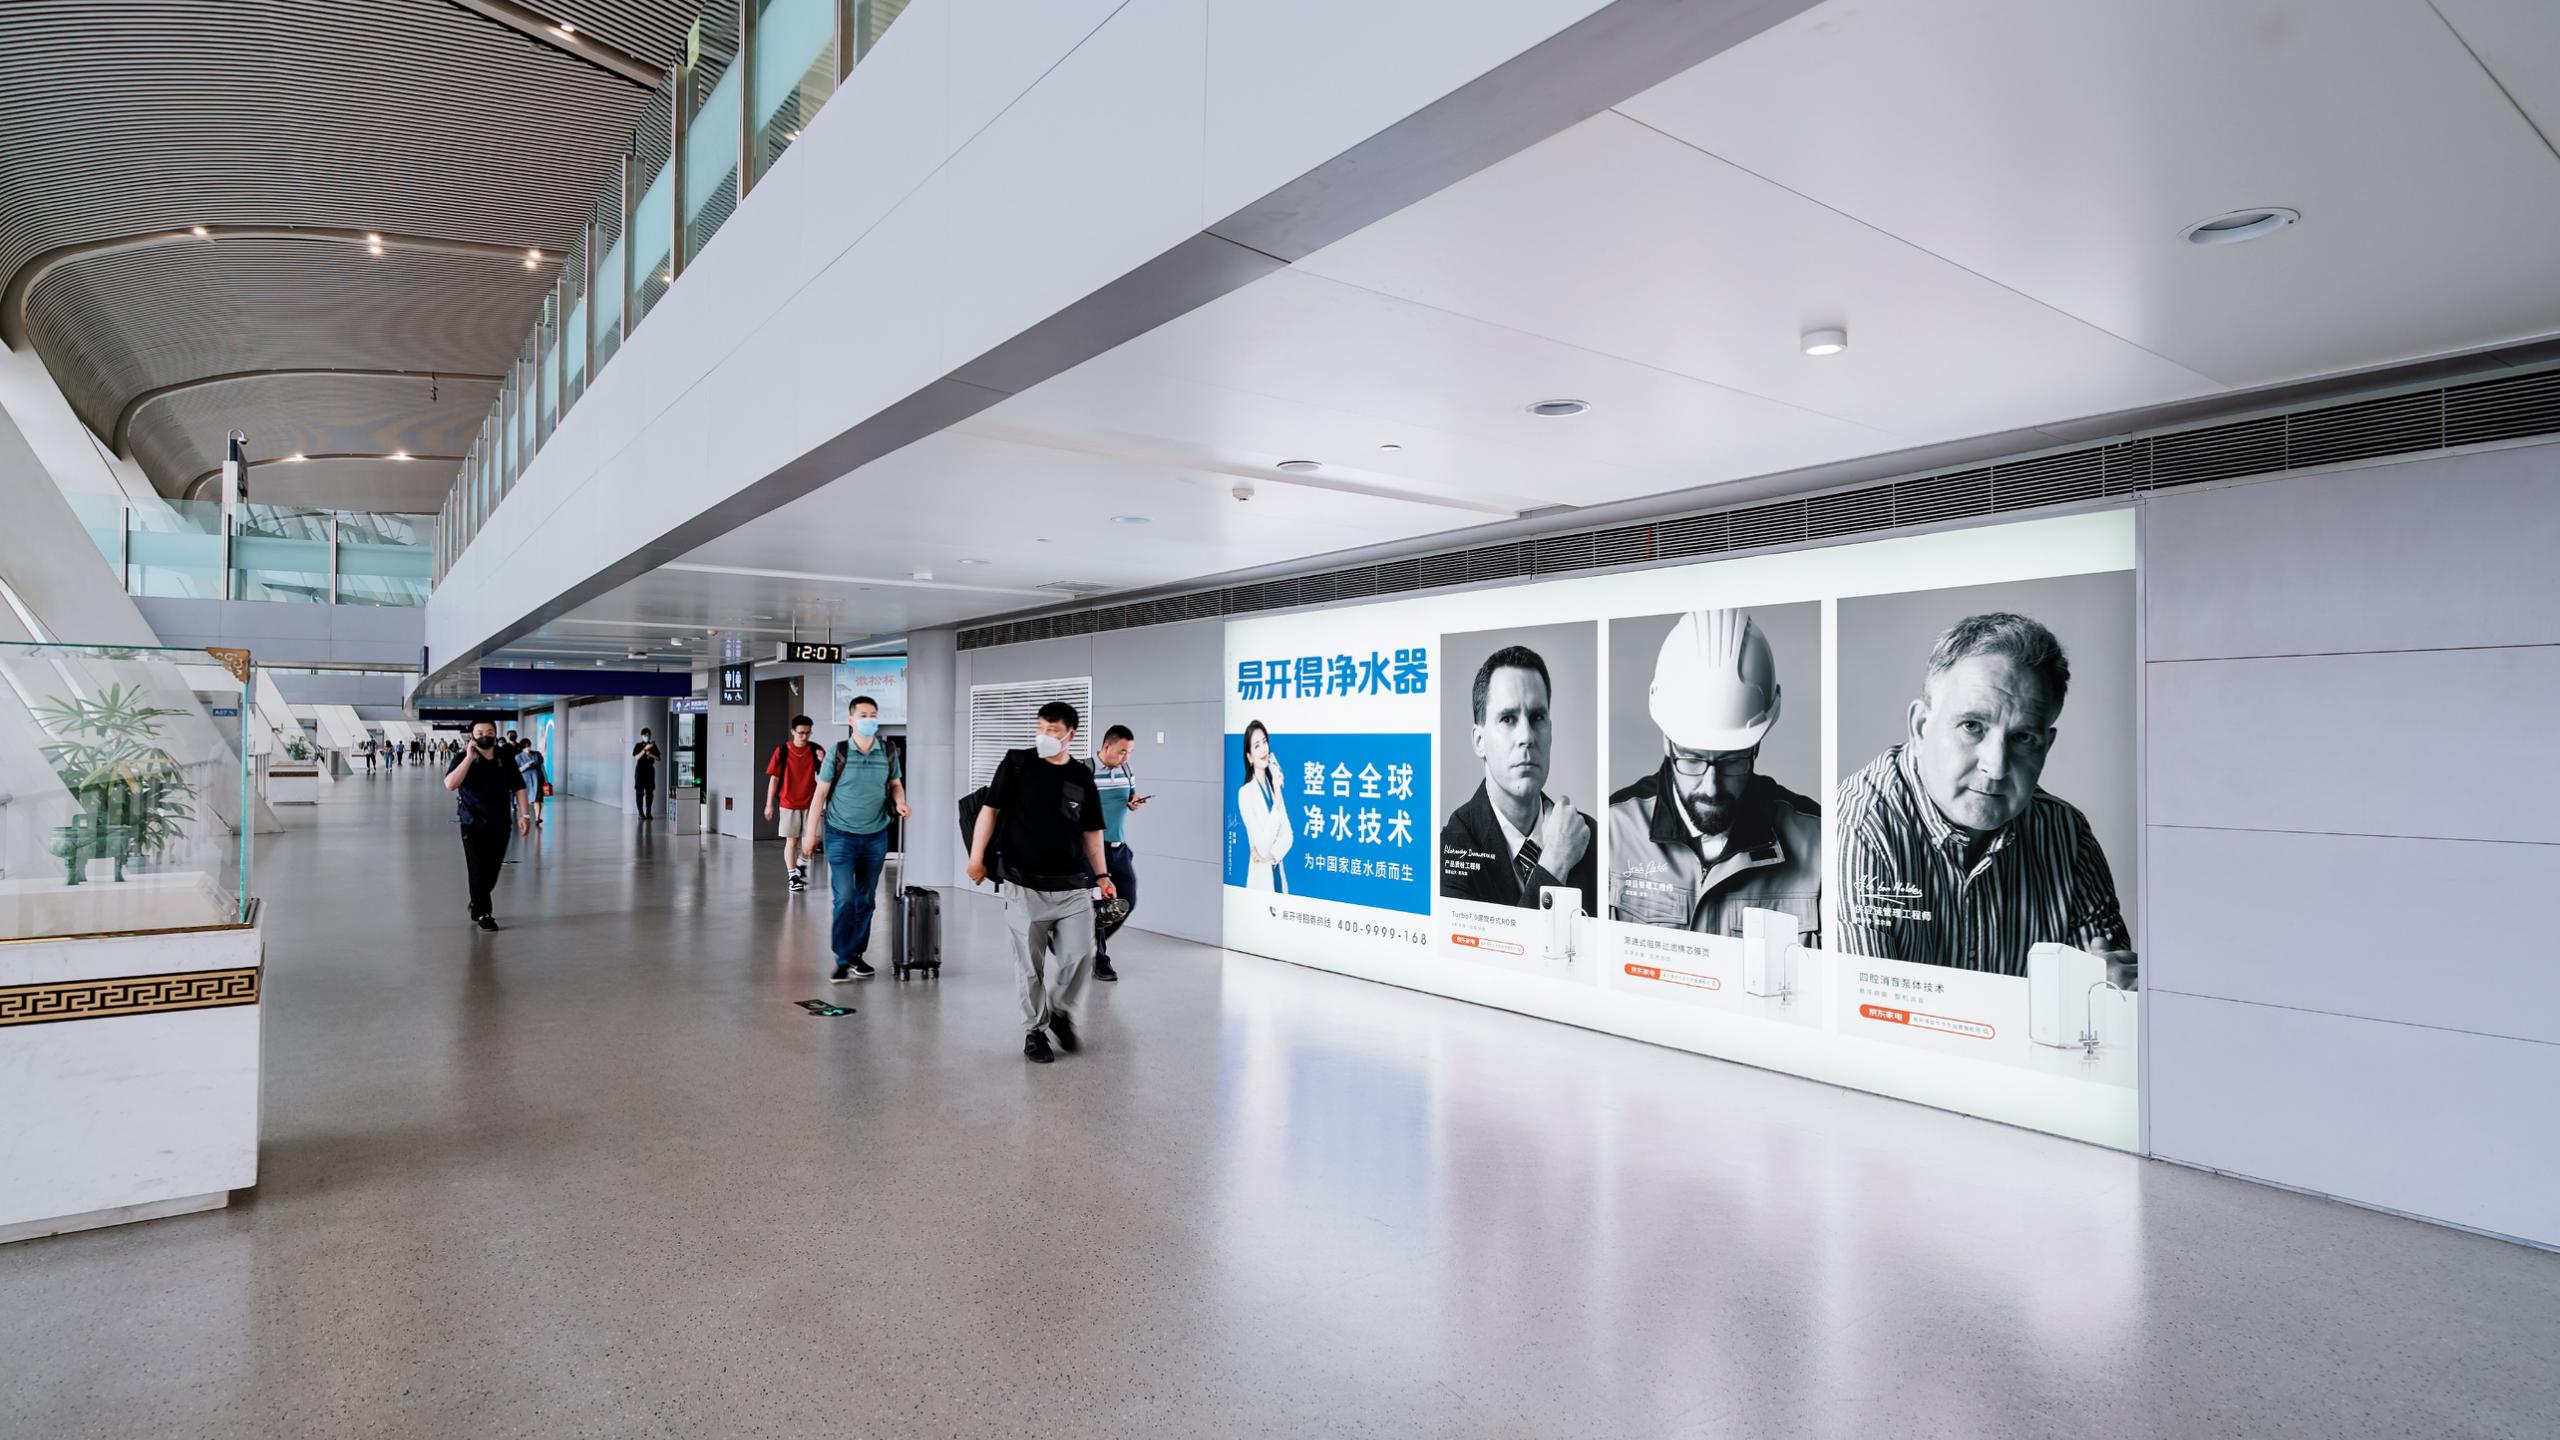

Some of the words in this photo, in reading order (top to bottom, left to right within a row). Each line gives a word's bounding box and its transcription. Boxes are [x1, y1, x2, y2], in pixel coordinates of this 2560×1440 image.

[796, 646, 839, 660] 12:07
[1237, 647, 1429, 701] 易开得净水器
[1303, 760, 1414, 801] 整合全球
[1303, 804, 1413, 847] 净水技术
[1303, 853, 1415, 882] 为中国家庭水质而生
[1337, 919, 1427, 945] 400-9999-168
